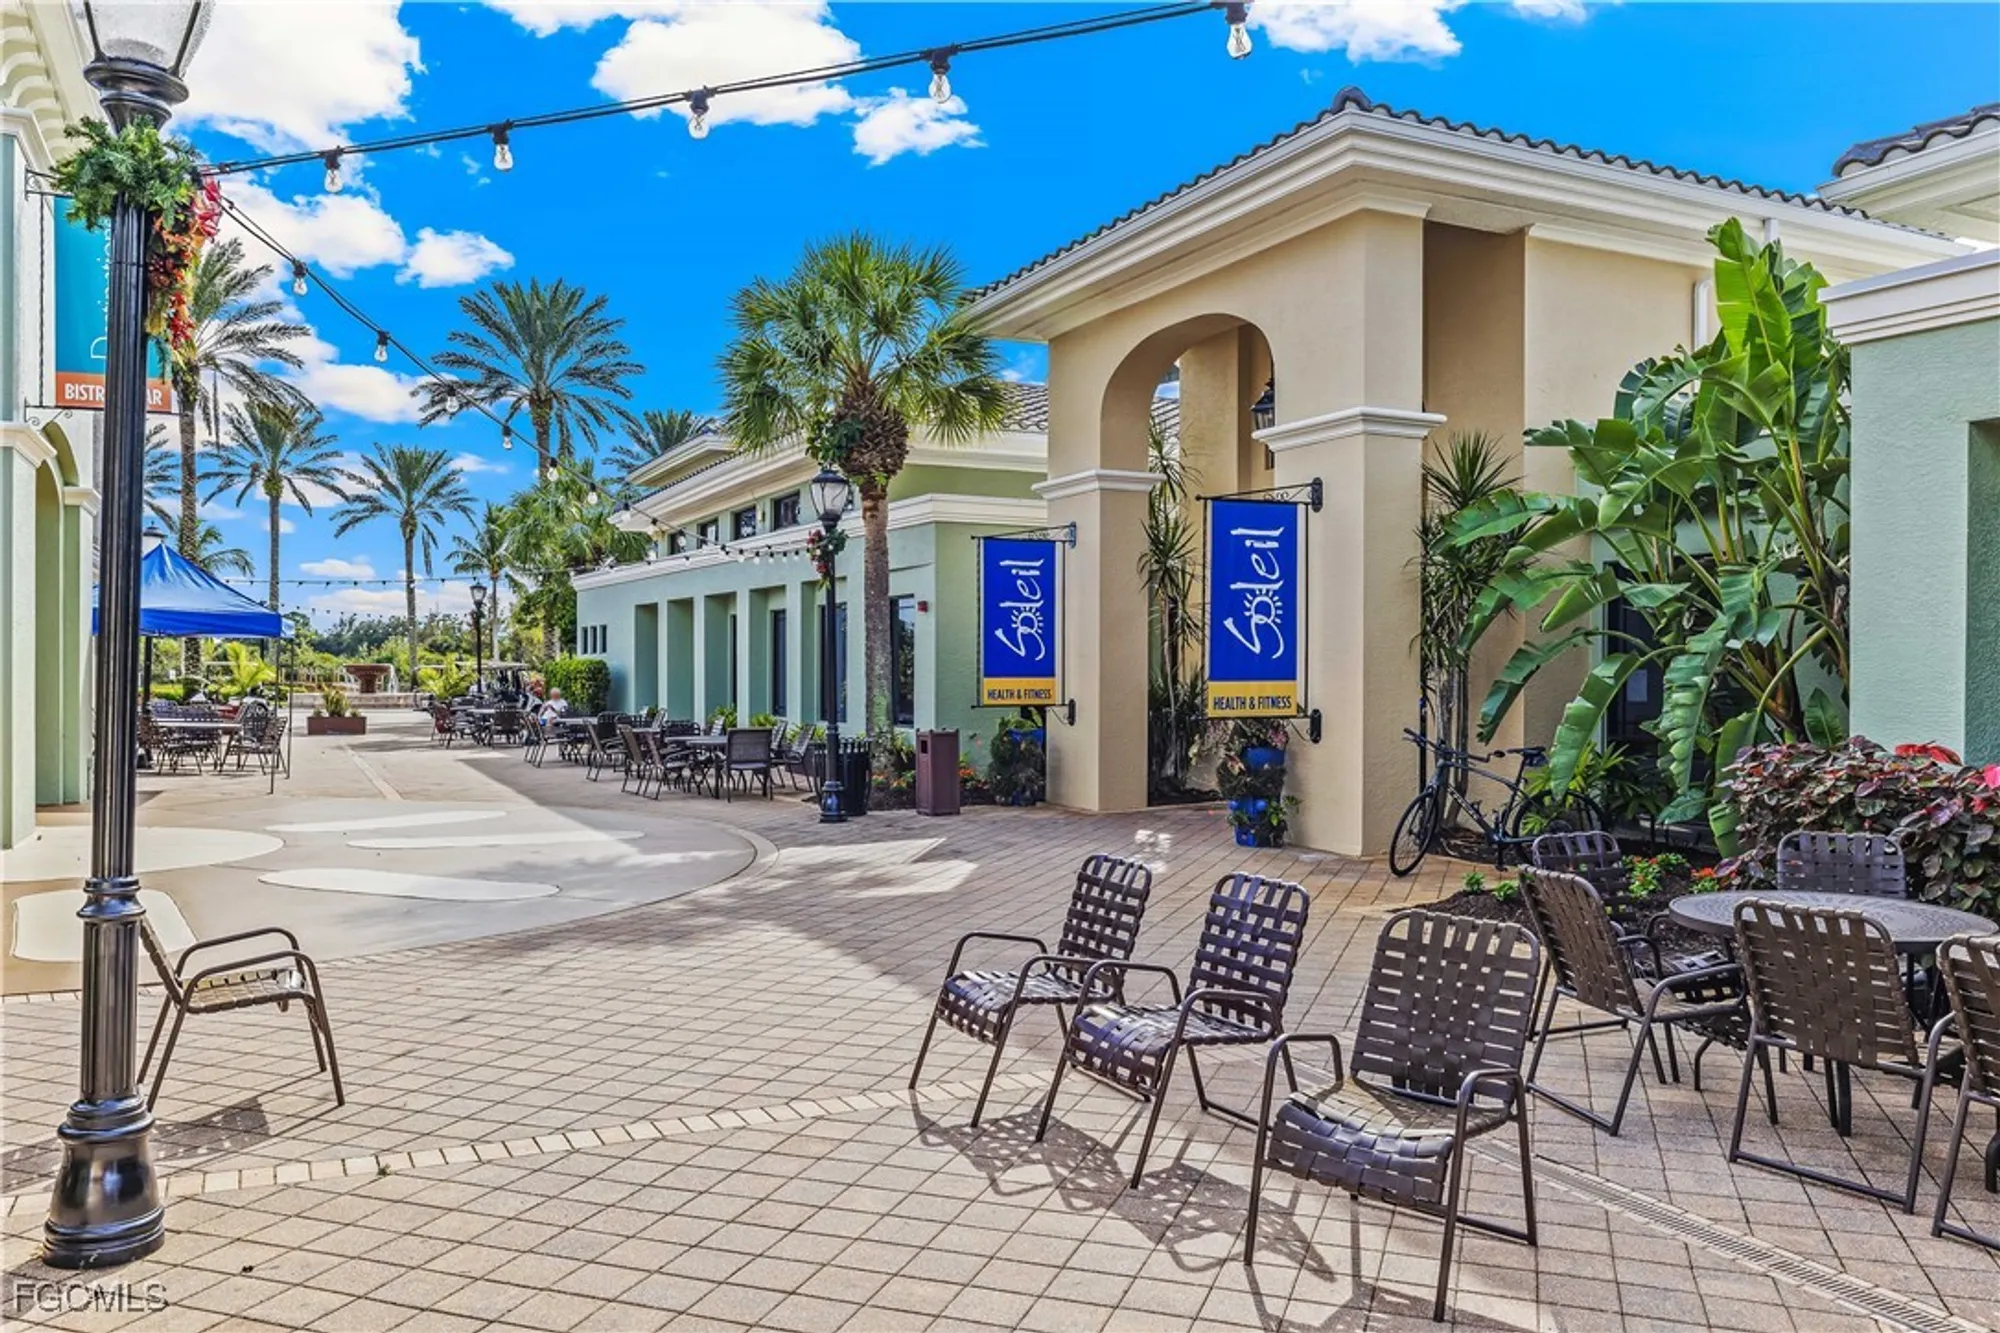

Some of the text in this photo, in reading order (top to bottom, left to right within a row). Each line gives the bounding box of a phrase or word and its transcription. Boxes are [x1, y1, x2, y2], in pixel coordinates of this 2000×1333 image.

[64, 383, 104, 401] BISTR
[1223, 526, 1285, 659] Soleil
[994, 558, 1045, 661] Soleil
[988, 689, 1052, 699] HEALTH & FITNESS
[1213, 695, 1292, 710] HEALTH & FITNESS
